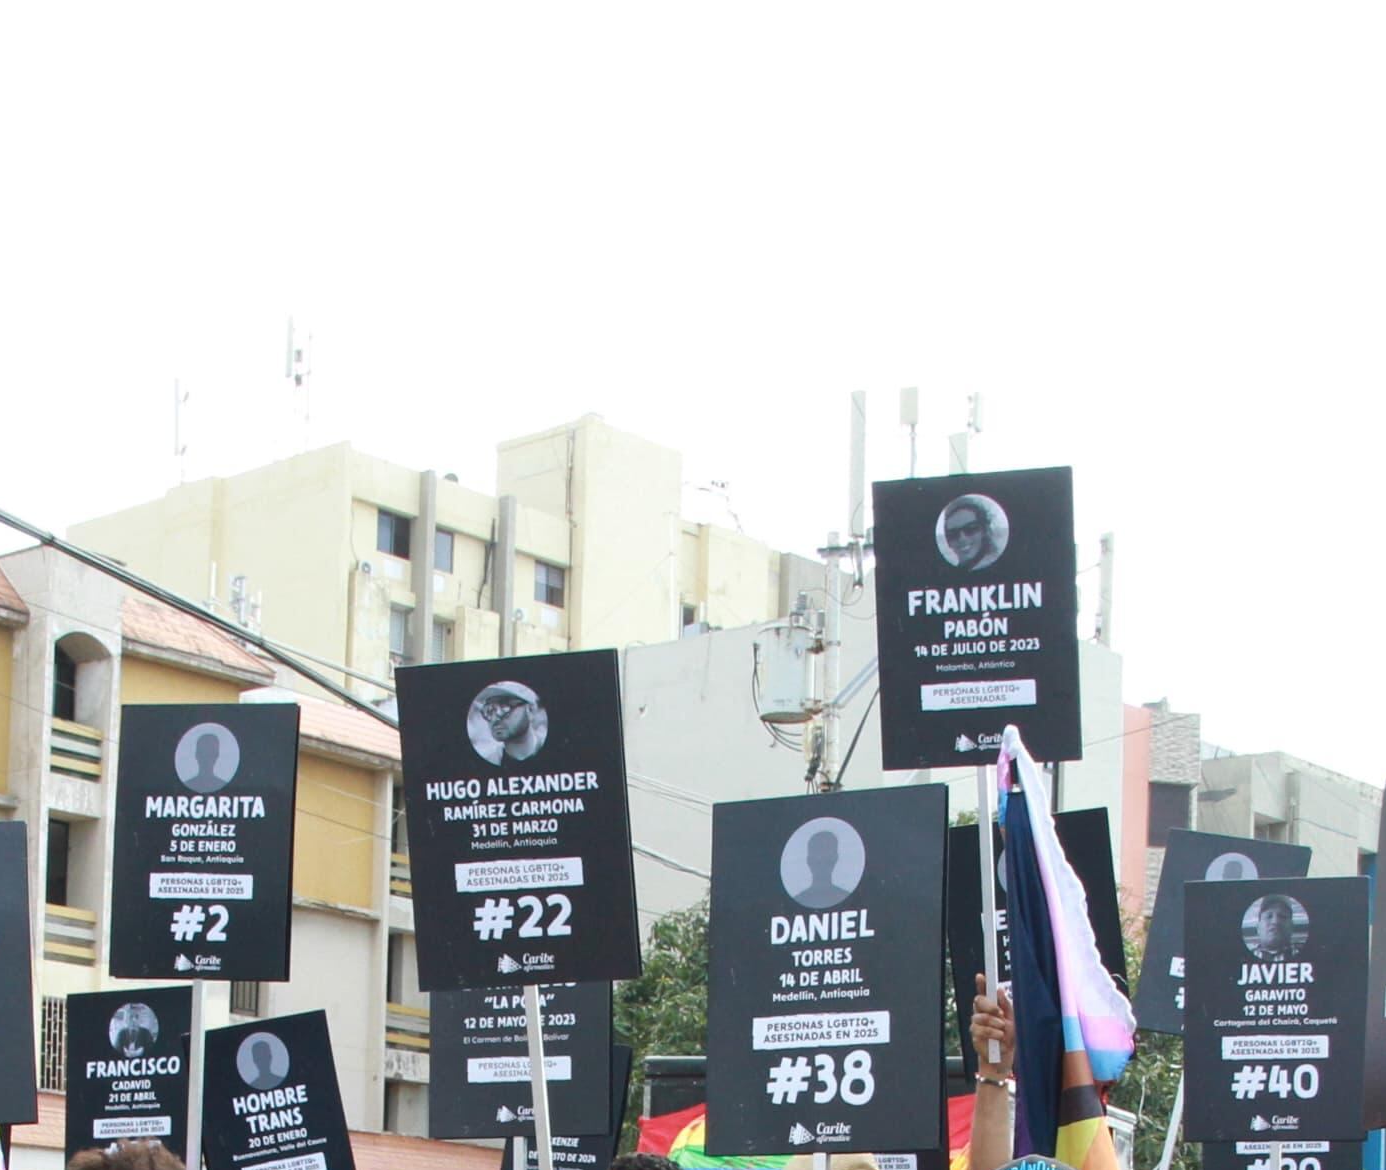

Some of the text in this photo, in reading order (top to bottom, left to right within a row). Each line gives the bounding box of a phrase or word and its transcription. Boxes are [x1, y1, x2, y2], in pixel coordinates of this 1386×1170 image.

[908, 582, 1042, 616] FRANKLIN
[944, 613, 1008, 639] PABÓN
[914, 638, 1040, 658] 14 DE JULIO DE 2023
[933, 686, 980, 696] PERSONAS
[950, 694, 1007, 704] ASESINADAS
[426, 772, 599, 800] HUGO ALEXANDER
[145, 796, 265, 818] MARGARITA
[444, 798, 584, 821] RAMÍREZ CARMONA
[172, 820, 236, 837] GONZÁLEZ
[472, 820, 558, 837] 31 DE MARZO
[170, 840, 236, 852] 5 DE ENERO
[471, 837, 557, 850] Medellín, Antioquia
[466, 872, 569, 886] ASESINADAS EN 2025
[468, 864, 565, 876] PERSONAS LGBTIQ+
[171, 904, 229, 941] #2
[473, 893, 572, 941] #22
[770, 909, 875, 945] DANIEL
[523, 952, 554, 964] Caribe
[792, 948, 853, 967] TORRES
[779, 969, 863, 988] 14 DE ABRIL
[1237, 962, 1314, 986] JAVIER
[820, 988, 870, 1000] Antioquia
[1245, 988, 1306, 1002] GARAVITO
[1243, 1004, 1308, 1017] 12 DE MAYO
[464, 1013, 576, 1029] 12 DE MAYO 2023
[767, 1018, 875, 1032] PERSONAS LGBTIQ+
[763, 1028, 878, 1044] ASESINADAS EN 2025
[86, 1056, 180, 1079] FRANCISCO
[112, 1079, 151, 1091] CADAVID
[766, 1049, 875, 1105] #38
[1231, 1063, 1319, 1101] #40
[109, 1091, 156, 1103] 21 DE ABRIL
[233, 1085, 308, 1115] HOMBRE
[246, 1109, 303, 1134] TRANS
[817, 1122, 851, 1135] Caribe
[249, 1128, 307, 1148] 20 DE ENERO
